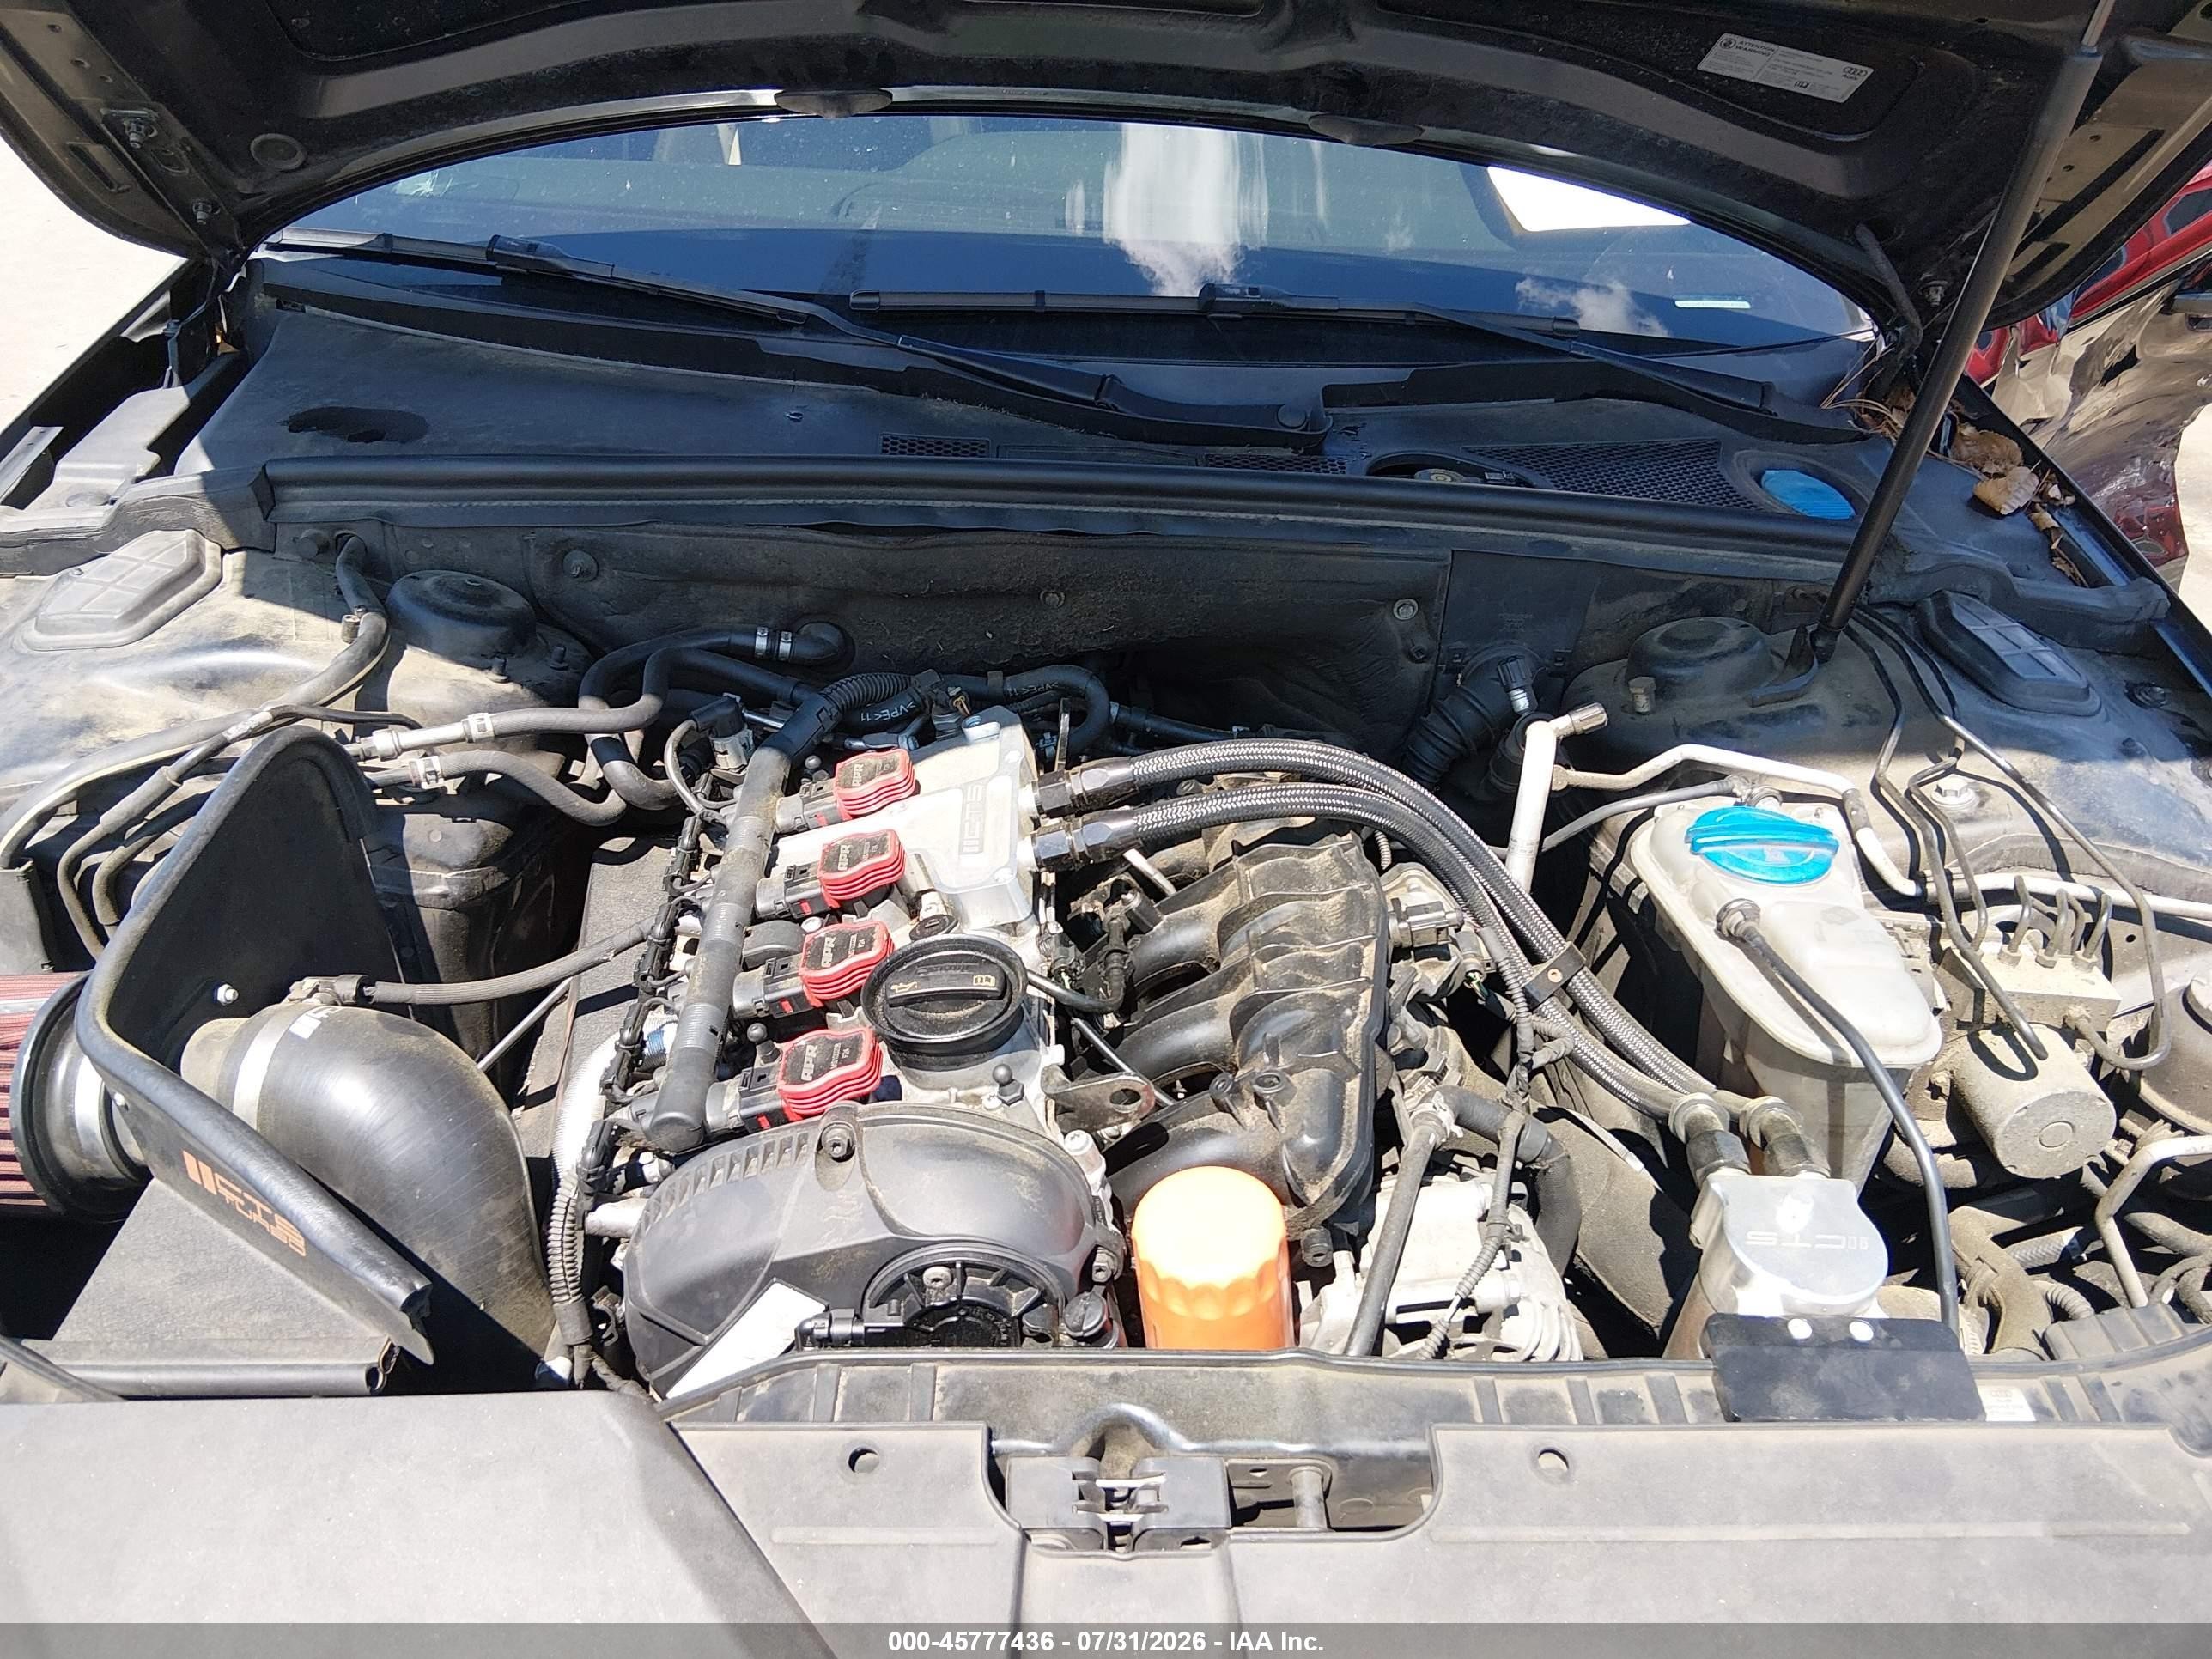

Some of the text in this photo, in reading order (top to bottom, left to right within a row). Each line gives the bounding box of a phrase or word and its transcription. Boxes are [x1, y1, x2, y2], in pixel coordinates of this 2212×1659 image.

[1735, 45, 1771, 58] WARNING
[1738, 40, 1775, 52] ATTENTION
[851, 763, 865, 787] APR
[837, 844, 851, 871] APR
[821, 936, 836, 968] APR
[801, 1044, 818, 1081] APR
[1745, 1230, 1846, 1249] CTS
